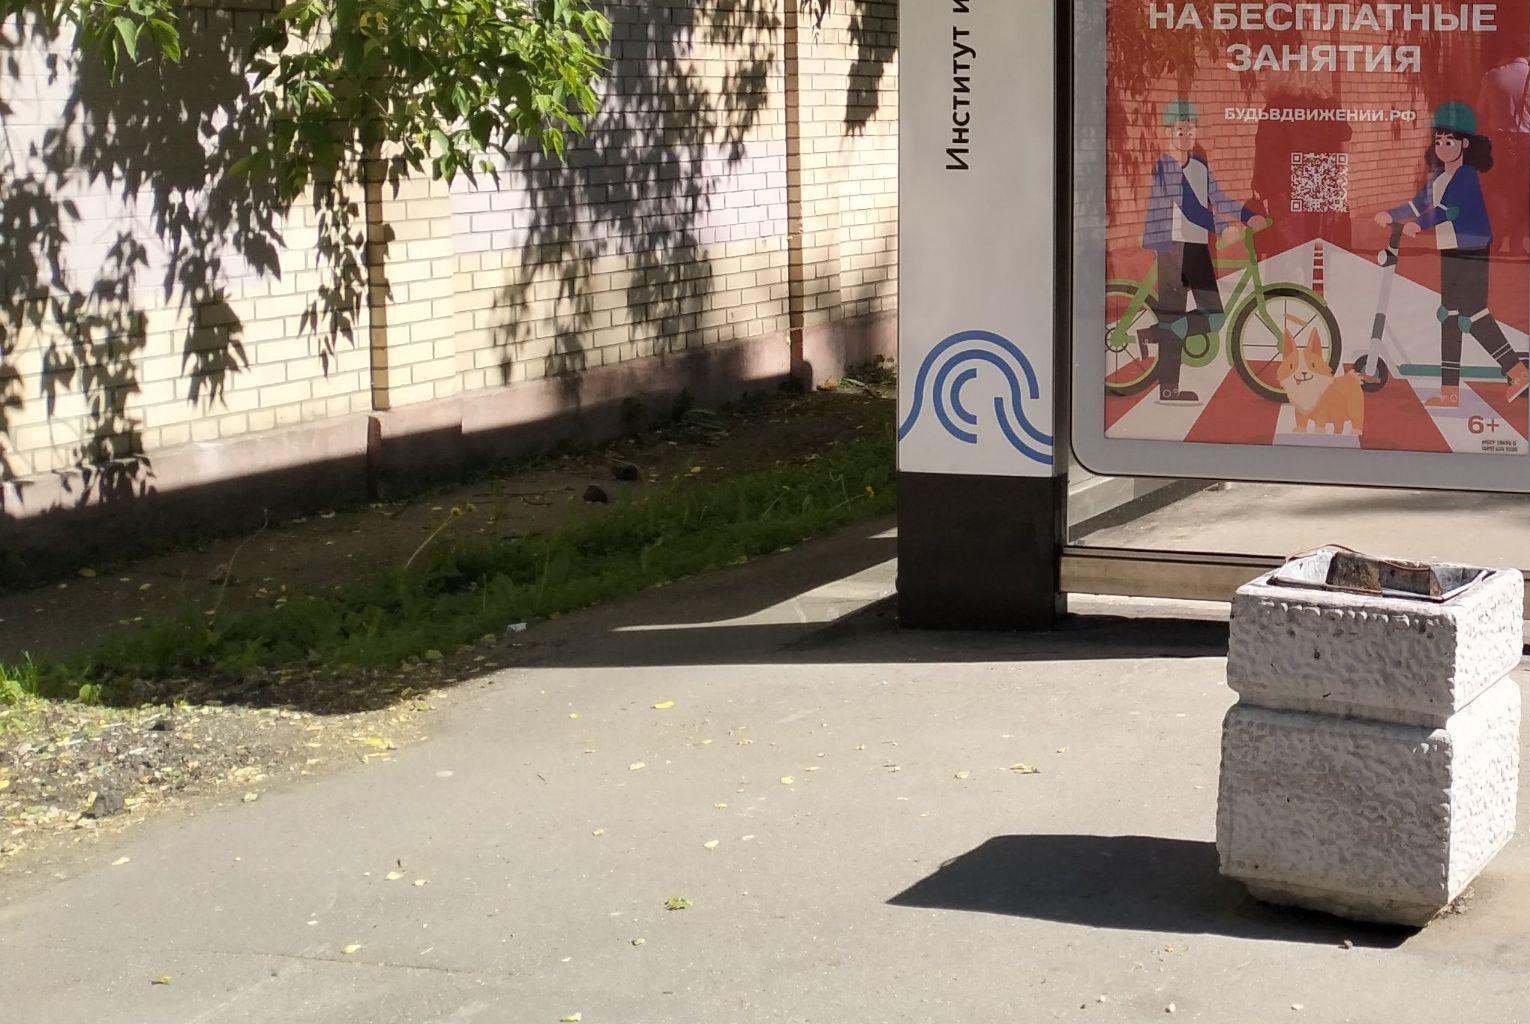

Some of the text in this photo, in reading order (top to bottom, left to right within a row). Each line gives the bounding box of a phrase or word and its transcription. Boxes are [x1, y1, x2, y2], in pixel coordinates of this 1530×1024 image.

[1148, 2, 1498, 32] НА БЕСПЛАТНЫЕ
[1225, 43, 1422, 73] ЗАНЯТИЯ
[945, 26, 976, 172] Институт
[1224, 107, 1417, 123] БУДЬВДВИЖЕНИИ.РФ
[1467, 415, 1499, 434] 6+
